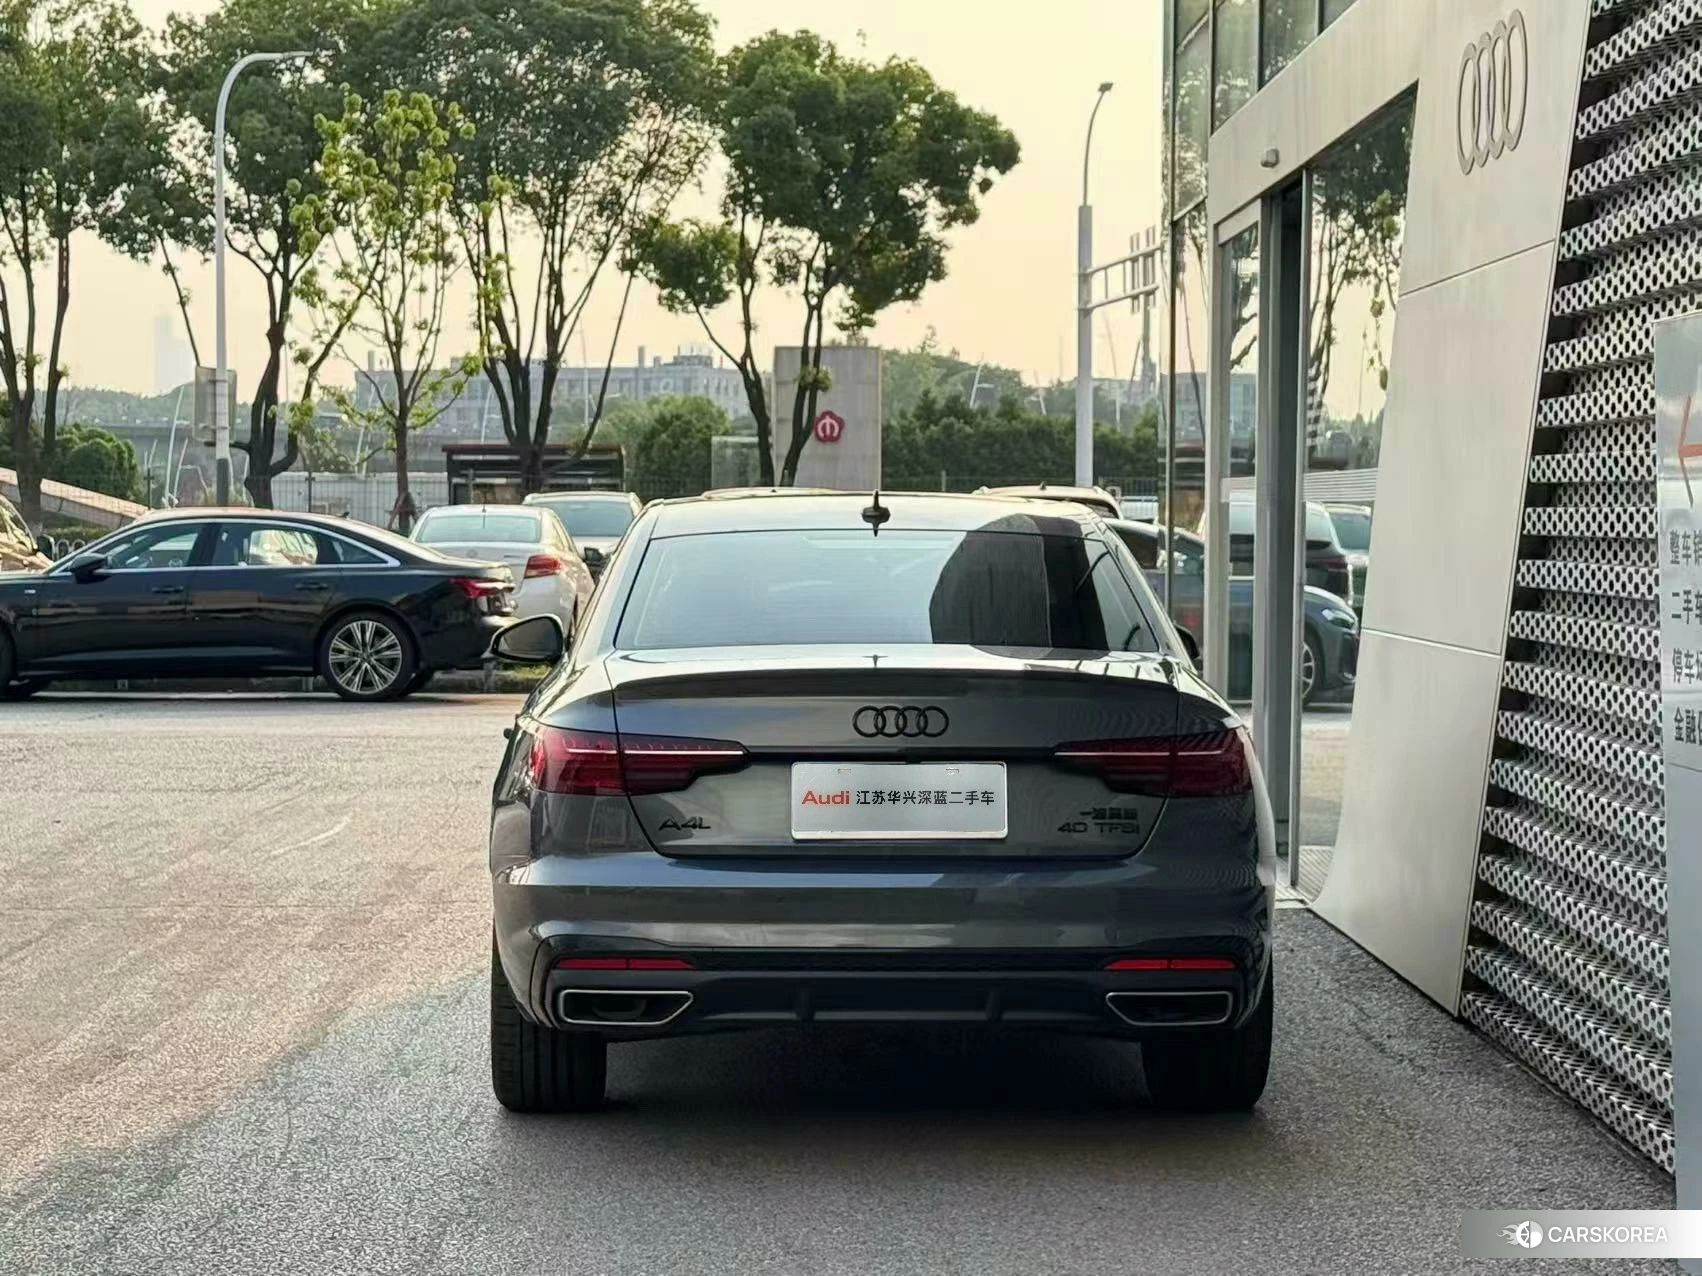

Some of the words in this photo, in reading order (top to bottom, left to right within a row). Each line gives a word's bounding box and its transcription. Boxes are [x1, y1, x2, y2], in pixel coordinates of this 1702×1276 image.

[801, 790, 850, 805] Audi
[855, 790, 995, 805] 江苏华兴深蓝二手车
[658, 816, 712, 831] A4L
[1057, 821, 1089, 833] 40
